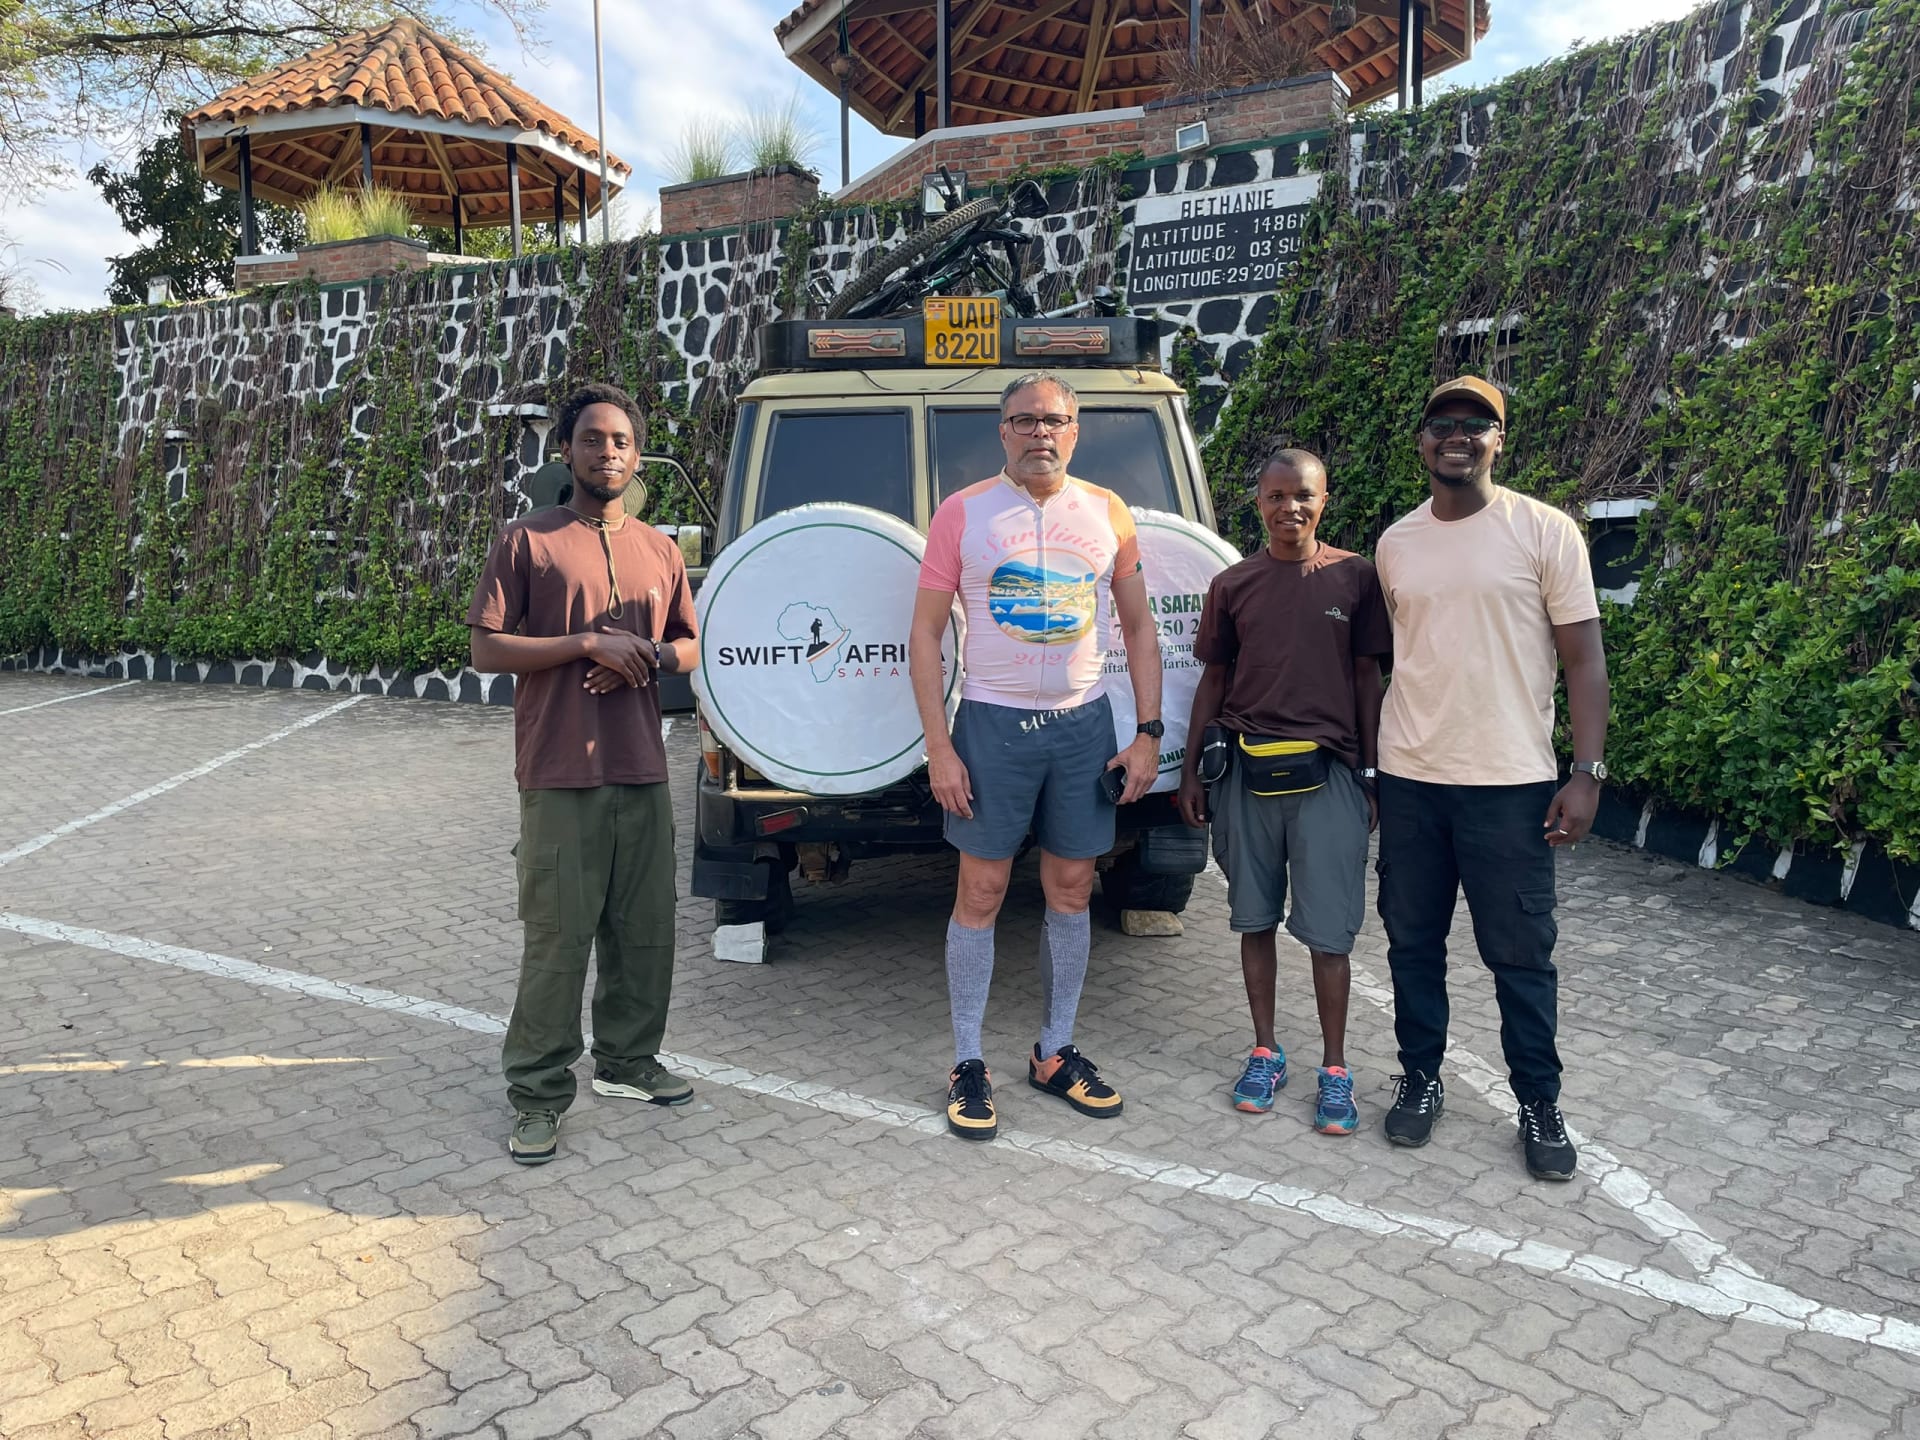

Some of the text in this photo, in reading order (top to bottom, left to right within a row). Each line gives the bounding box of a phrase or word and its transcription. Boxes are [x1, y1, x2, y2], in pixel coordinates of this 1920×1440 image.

[1181, 189, 1275, 220] BETHANIE
[948, 302, 995, 329] UAU
[935, 332, 995, 360] 822U
[1161, 593, 1208, 615] SAFA
[718, 643, 946, 666] SWIFT AFRI
